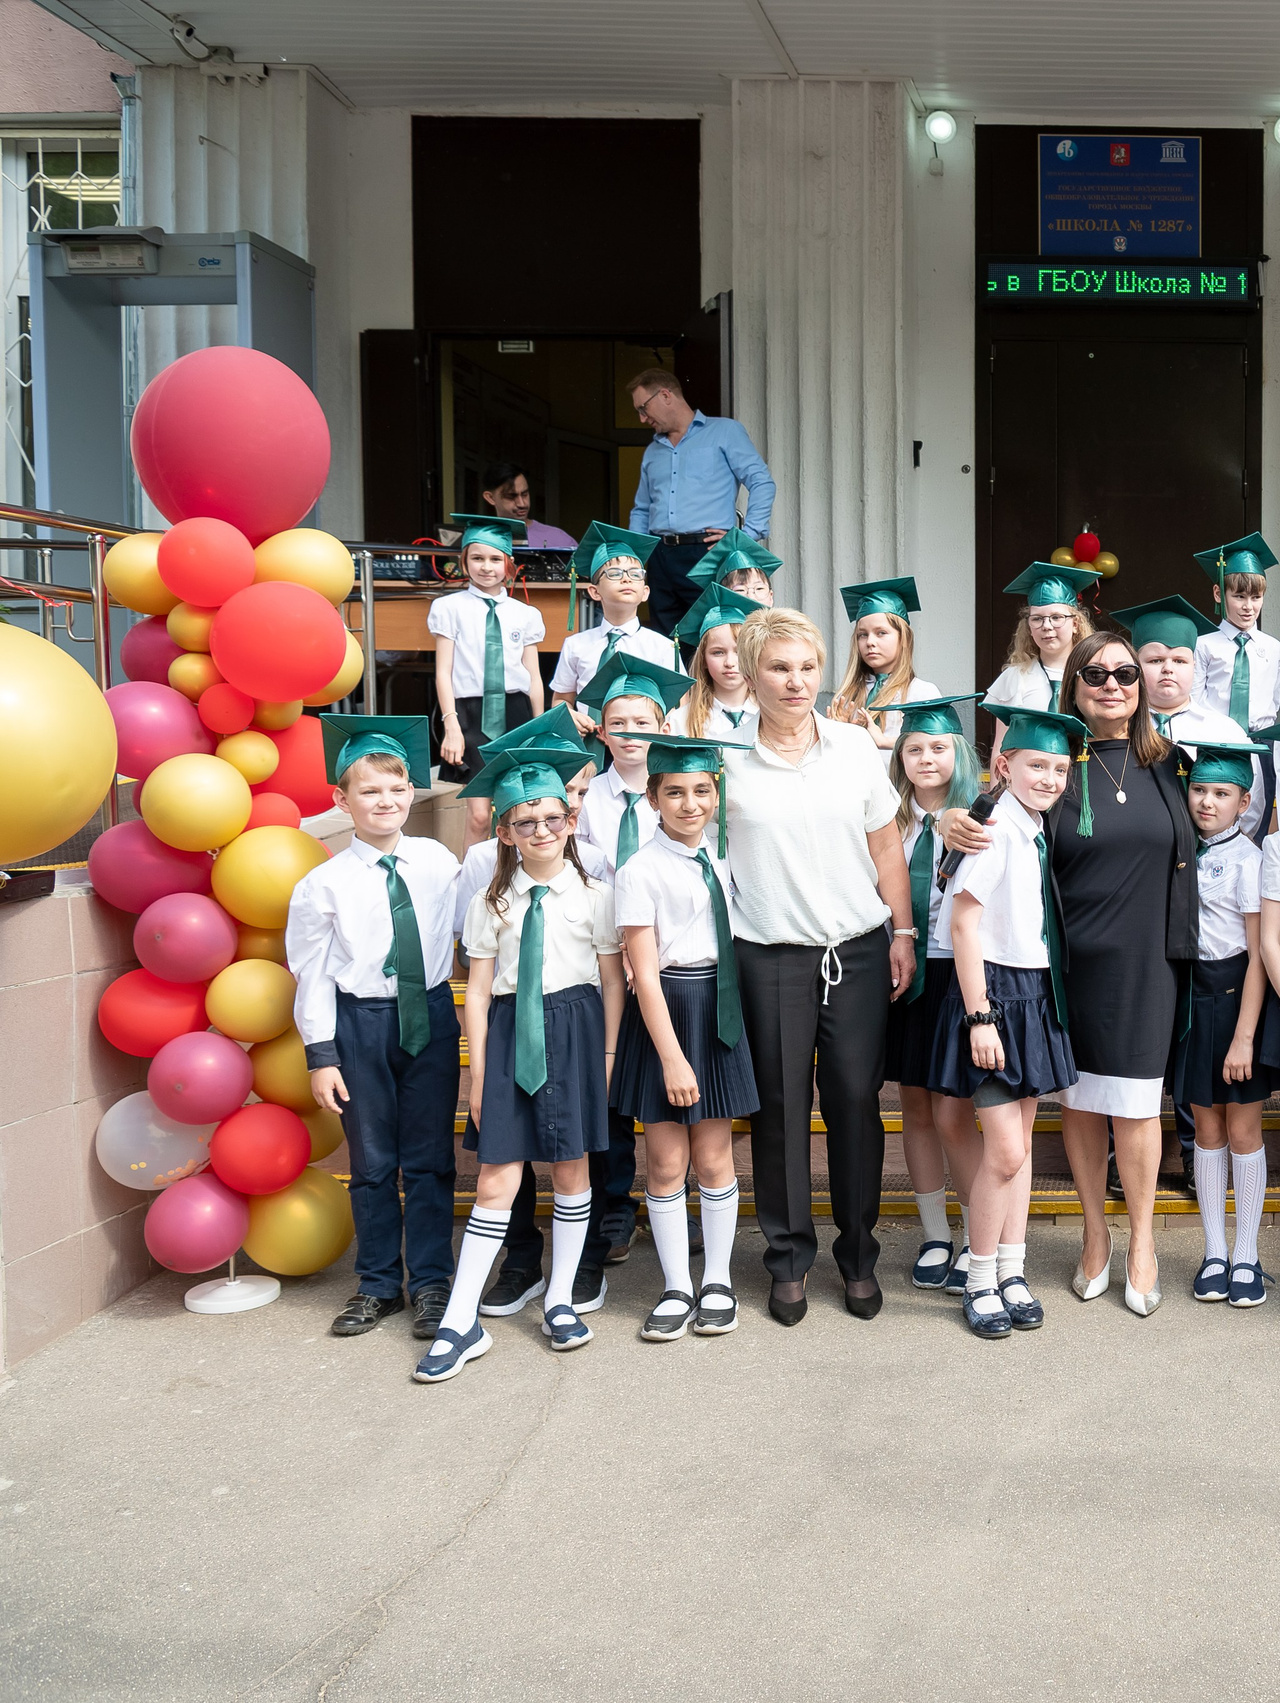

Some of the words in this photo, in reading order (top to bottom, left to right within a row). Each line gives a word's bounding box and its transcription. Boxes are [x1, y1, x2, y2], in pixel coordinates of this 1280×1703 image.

[1048, 219, 1121, 232] «ШКОЛА
[1150, 220, 1193, 232] 1287»
[1007, 275, 1020, 292] в
[1038, 269, 1108, 293] ГБОУ
[1115, 271, 1192, 294] Школа
[1200, 272, 1227, 294] №
